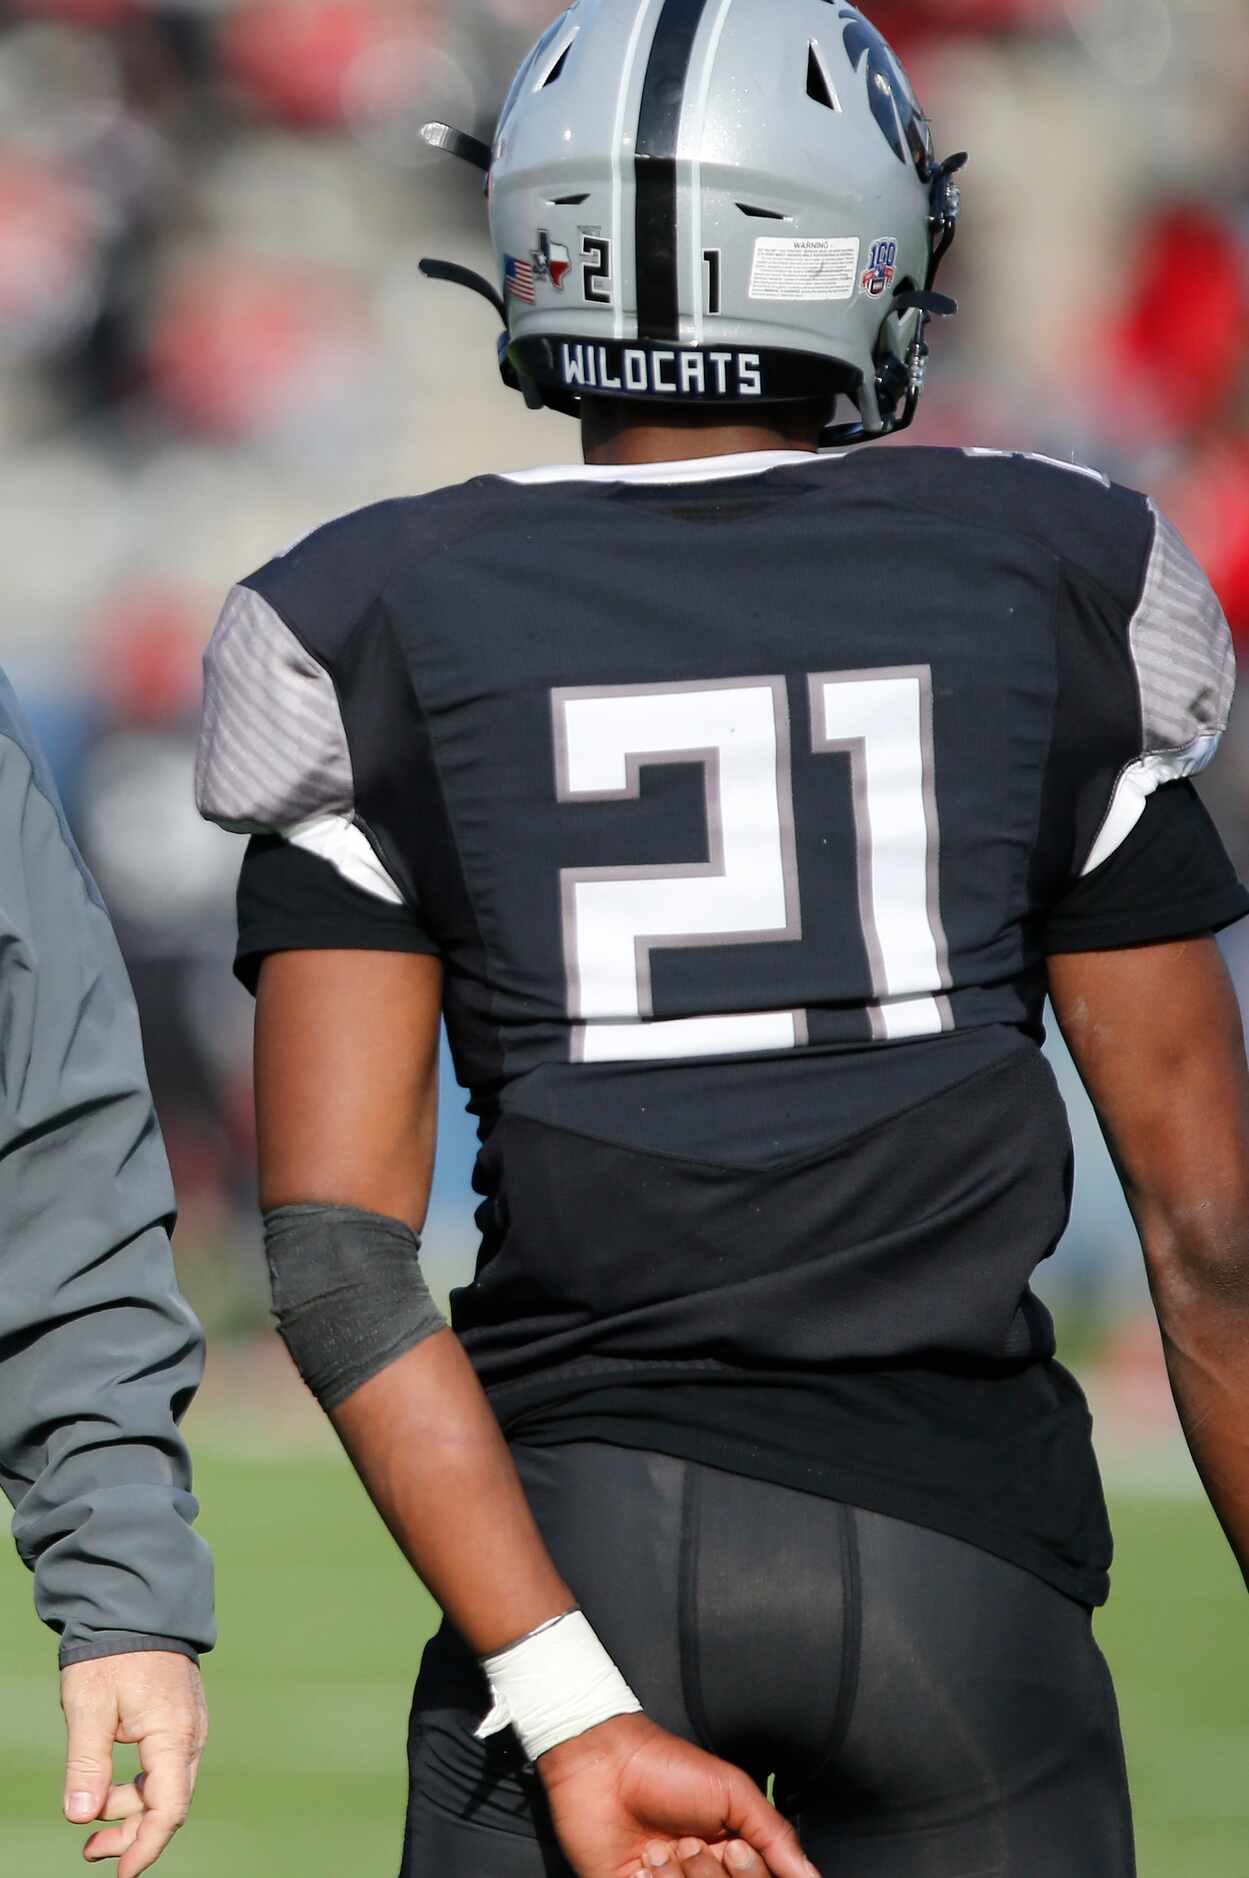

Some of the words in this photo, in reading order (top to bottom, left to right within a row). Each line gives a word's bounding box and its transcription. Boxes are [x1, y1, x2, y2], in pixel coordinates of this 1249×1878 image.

[793, 240, 829, 249] WARNING
[563, 343, 761, 394] WILDCATS
[551, 664, 955, 1063] 21
